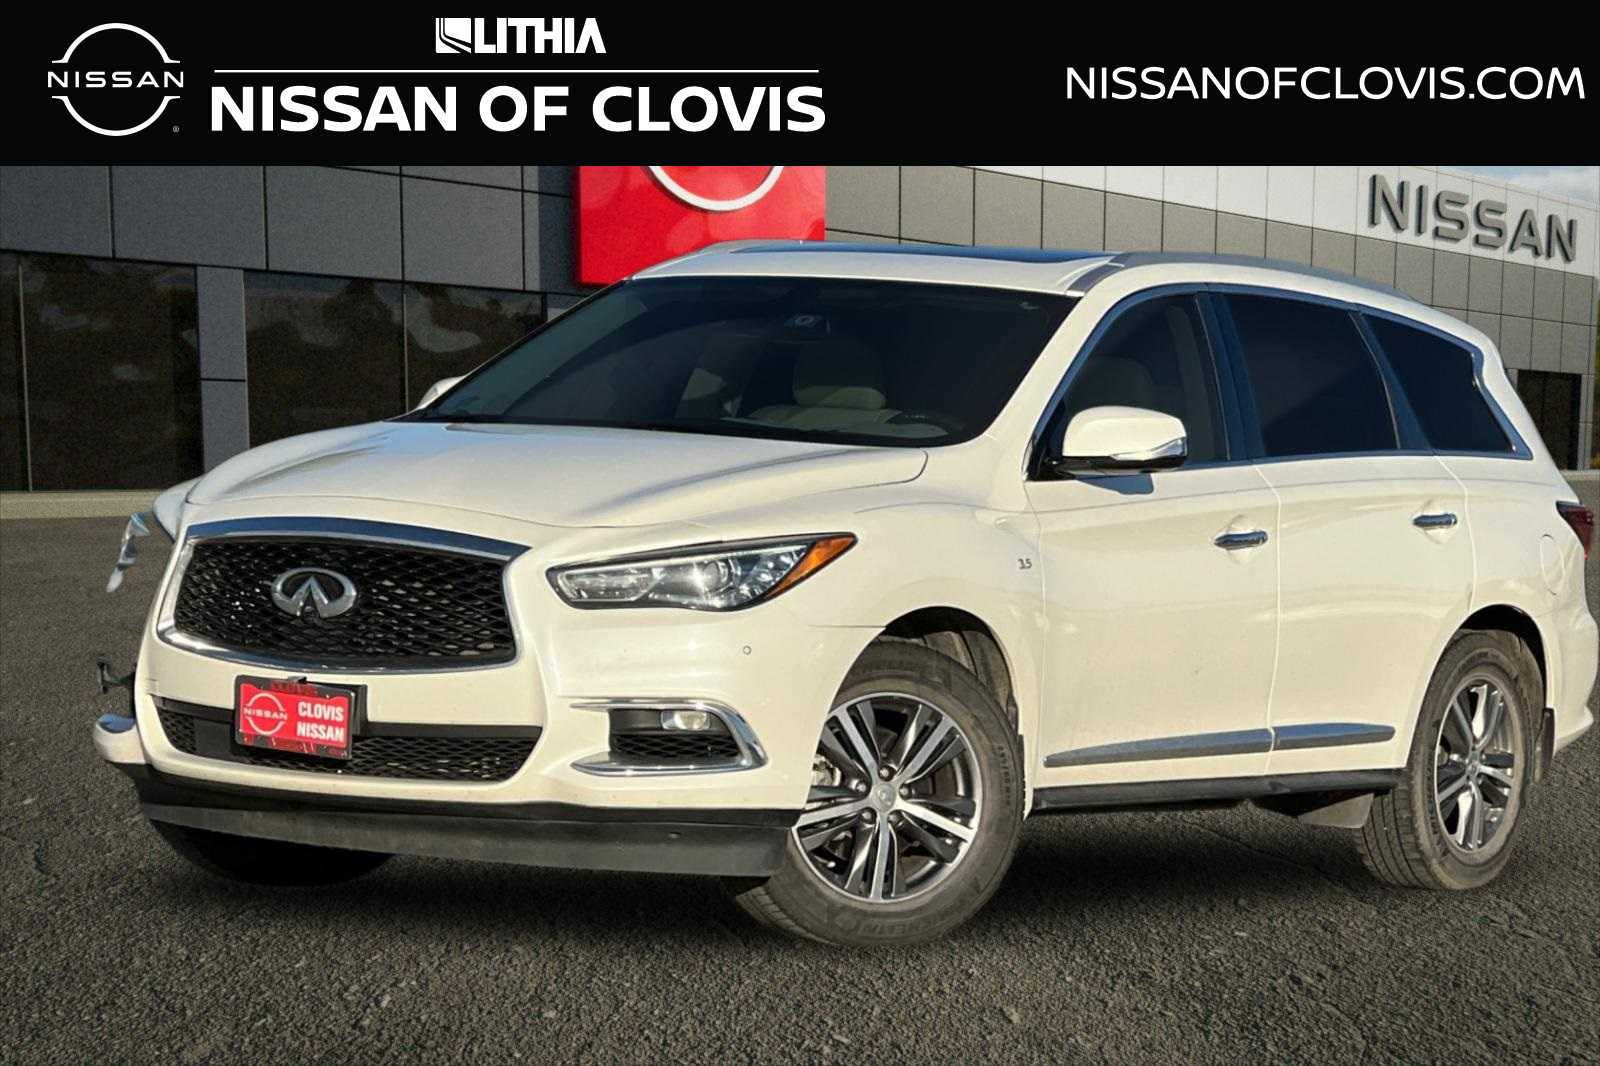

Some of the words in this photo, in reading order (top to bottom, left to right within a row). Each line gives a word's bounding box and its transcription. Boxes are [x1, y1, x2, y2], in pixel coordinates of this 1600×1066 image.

[1368, 174, 1578, 263] NISSAN
[243, 706, 288, 720] NISSAN
[298, 701, 344, 721] CLOVIS
[296, 721, 344, 742] NISSAN
